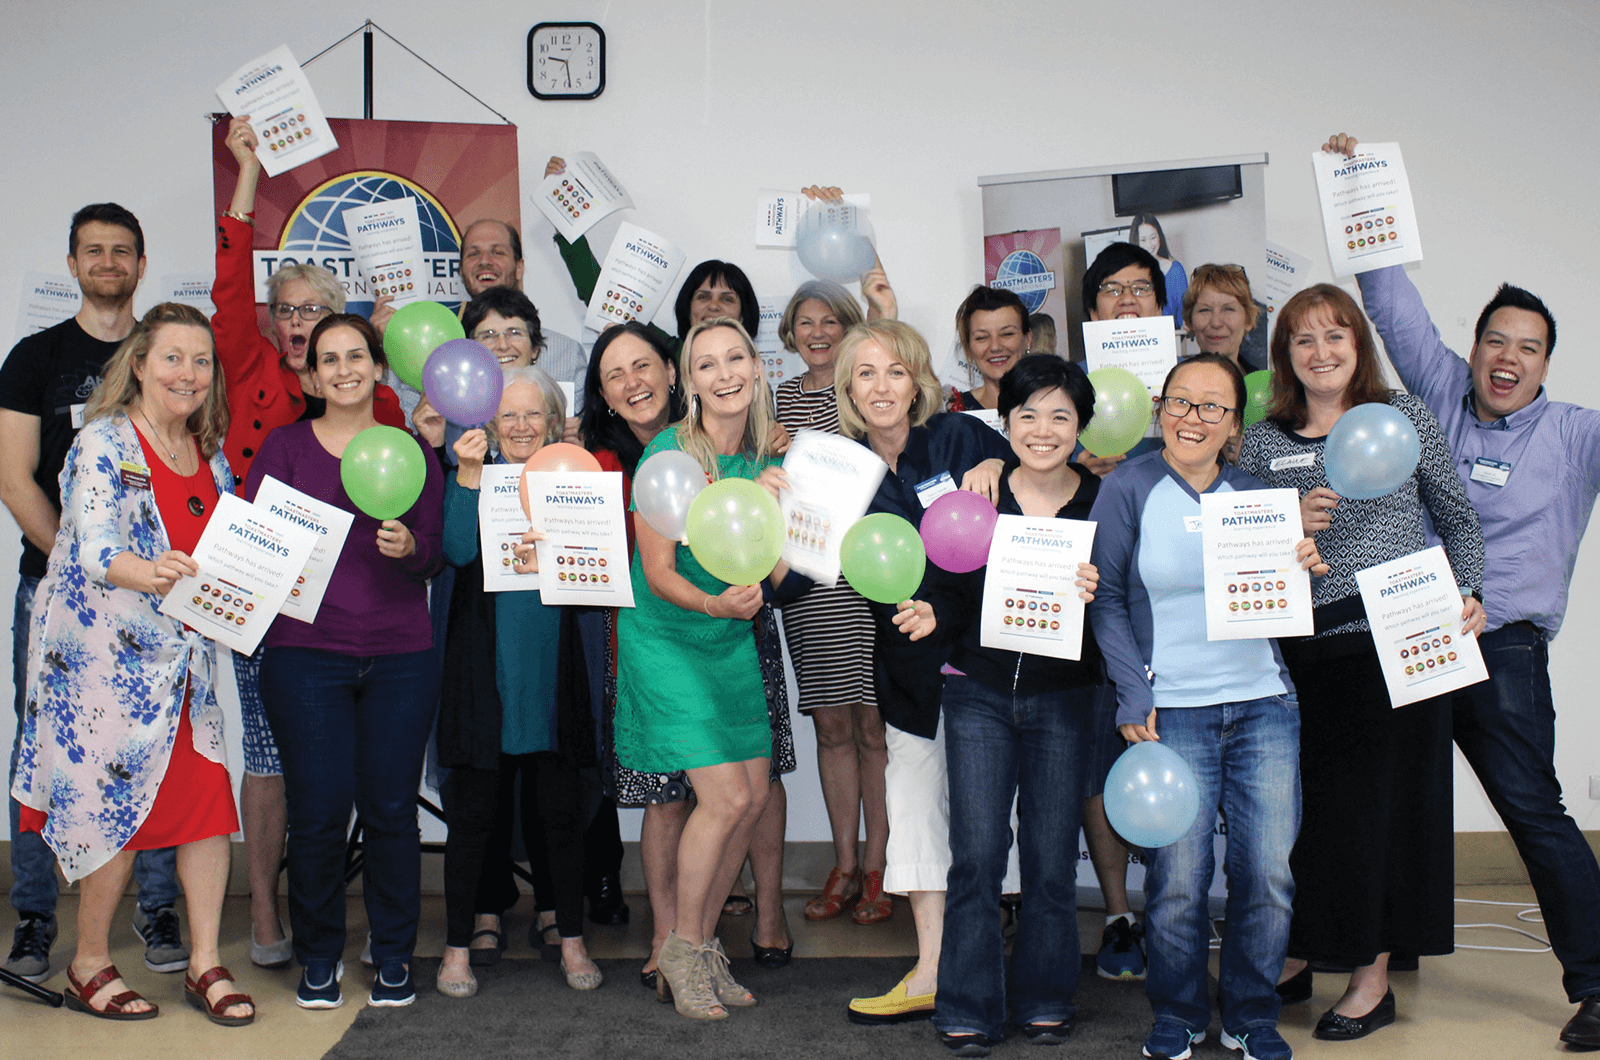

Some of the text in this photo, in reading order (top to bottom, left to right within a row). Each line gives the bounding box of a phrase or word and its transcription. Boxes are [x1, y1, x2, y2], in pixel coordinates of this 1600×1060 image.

[551, 36, 557, 45] 11
[562, 35, 571, 44] 12
[577, 36, 580, 44] 1
[540, 44, 549, 53] 10
[586, 43, 592, 52] 2
[539, 58, 545, 66] 9
[587, 57, 593, 66] 3
[235, 65, 282, 95] PATHWAYS
[552, 80, 557, 88] 7
[576, 79, 581, 87] 5
[1334, 161, 1387, 177] PATHWAYS
[1333, 186, 1359, 197] Pathways
[776, 198, 784, 235] PATHWAYS
[357, 218, 405, 233] PATHWAYS
[626, 243, 668, 268] PATHWAYS
[992, 274, 1052, 289] TOASTMASTERS
[35, 288, 78, 299] PATHWAYS
[1102, 338, 1158, 350] PATHWAYS
[546, 496, 604, 504] PATHWAYS
[270, 505, 328, 535] PATHWAYS
[284, 505, 319, 523] TOASTMASTERS
[1222, 513, 1286, 526] PATHWAYS
[229, 523, 289, 557] PATHWAYS
[245, 524, 282, 544] TOASTMASTERS
[1011, 535, 1073, 549] PATHWAYS
[1217, 541, 1250, 549] Pathways
[1265, 538, 1293, 546] arrived!
[214, 543, 283, 579] Pathways has arrived!
[1002, 557, 1074, 570] Pathways has arrived!
[1017, 570, 1038, 578] pathway
[1389, 571, 1424, 584] TOASTMASTERS
[1380, 573, 1437, 597] PATHWAYS
[1382, 594, 1448, 620] Pathways has arrived!
